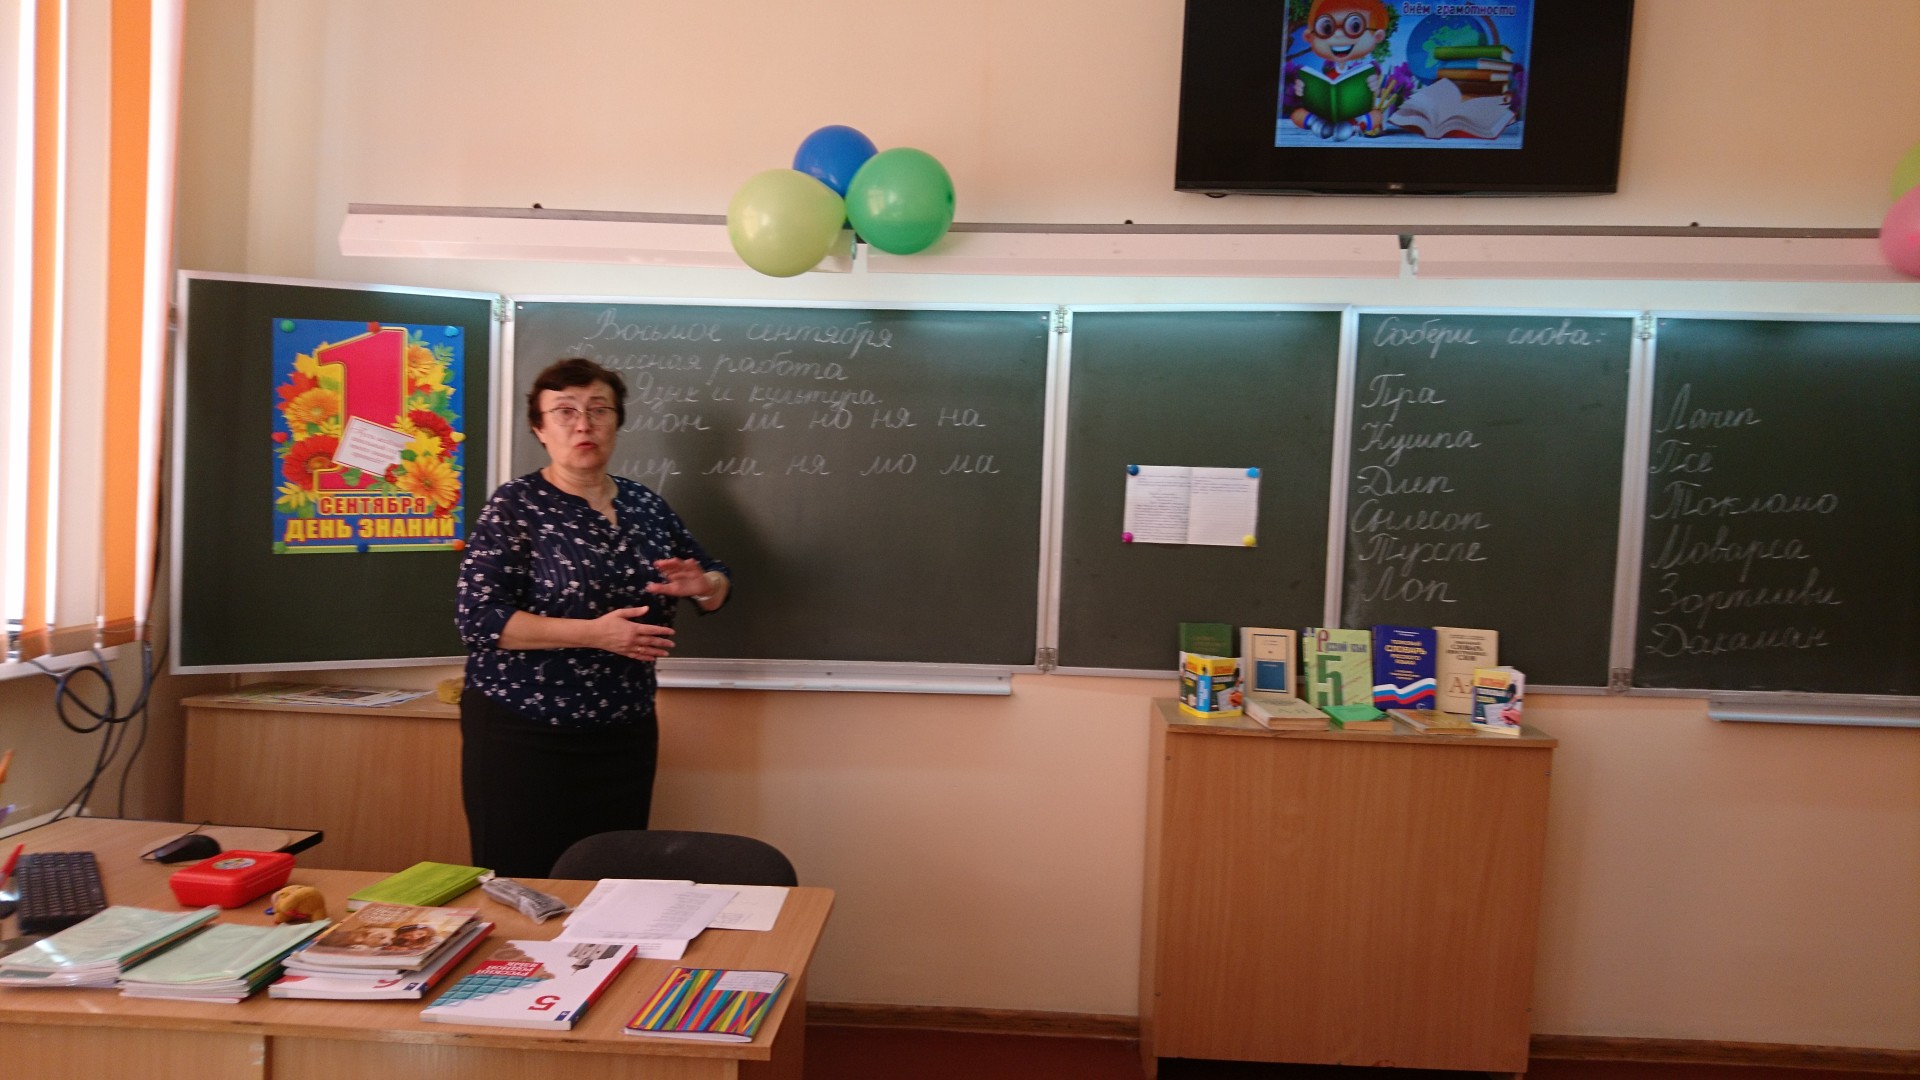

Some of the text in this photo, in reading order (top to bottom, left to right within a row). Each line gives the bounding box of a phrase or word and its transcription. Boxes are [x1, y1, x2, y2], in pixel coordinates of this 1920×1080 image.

[1402, 2, 1517, 18] днём грамотности
[583, 308, 894, 360] Восьмое сентября
[1373, 317, 1480, 359] Собери
[705, 350, 849, 386] работа
[711, 385, 735, 402] и
[1361, 373, 1447, 422] Пра
[314, 327, 409, 494] 1
[809, 409, 853, 429] но
[870, 408, 918, 429] ня
[938, 408, 988, 428] на
[1358, 421, 1483, 467] Кушпа
[939, 454, 1000, 475] ма
[319, 497, 427, 515] СЕНТЯБРЯ
[284, 515, 455, 542] ДЕНЬ ЗНАНИЙ
[527, 995, 561, 1011] 5
